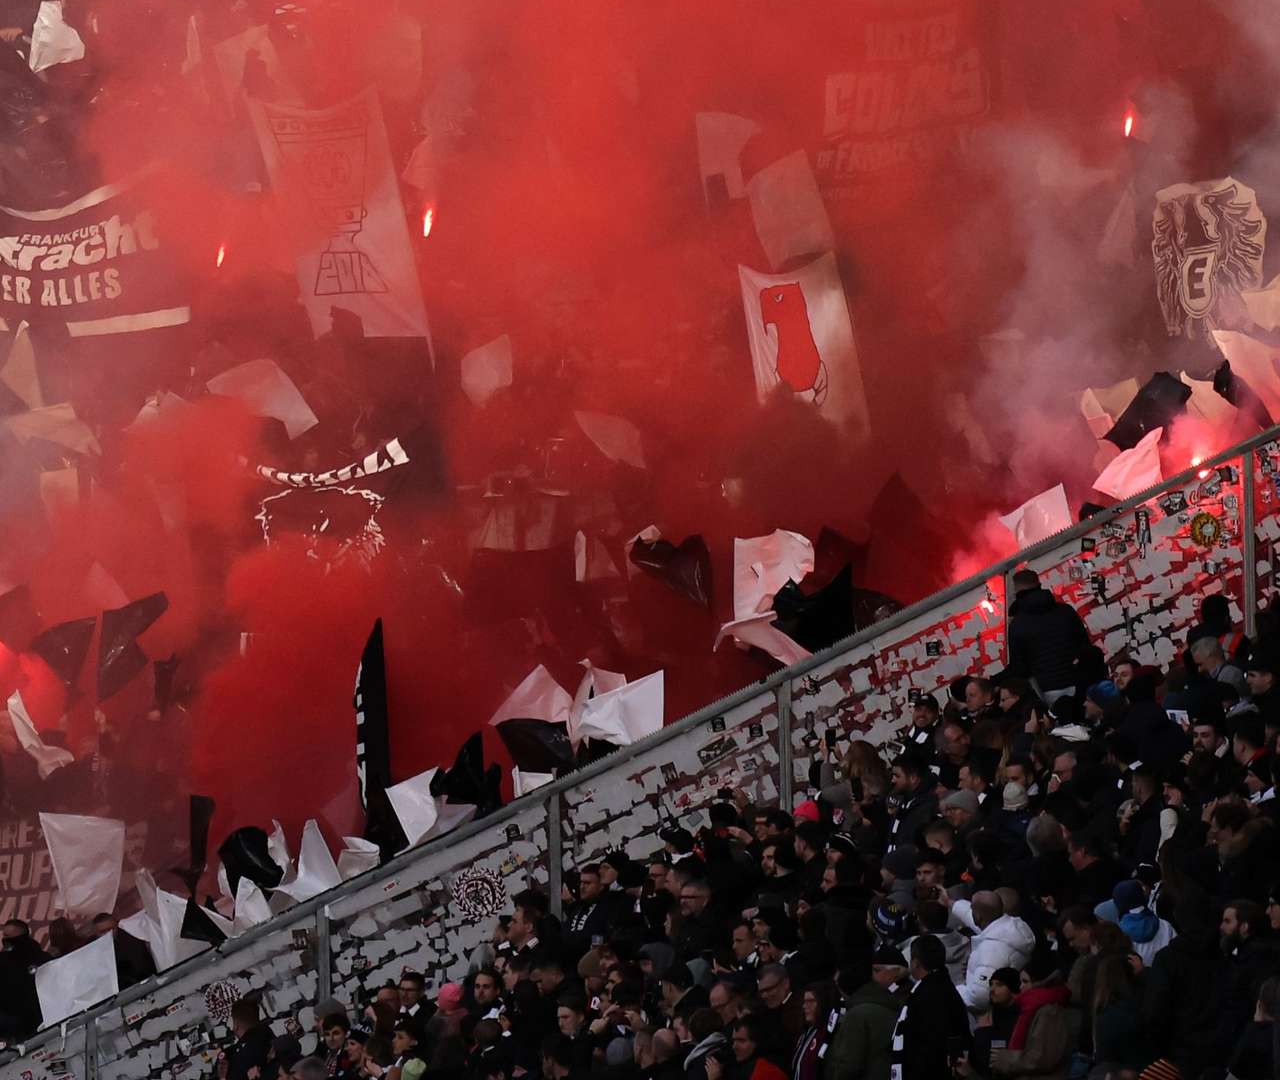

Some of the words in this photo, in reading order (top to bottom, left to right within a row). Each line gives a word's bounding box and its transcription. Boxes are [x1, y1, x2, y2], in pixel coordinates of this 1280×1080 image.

[21, 221, 110, 246] FRANKFURT
[41, 268, 122, 307] ALLES
[1188, 257, 1208, 300] E
